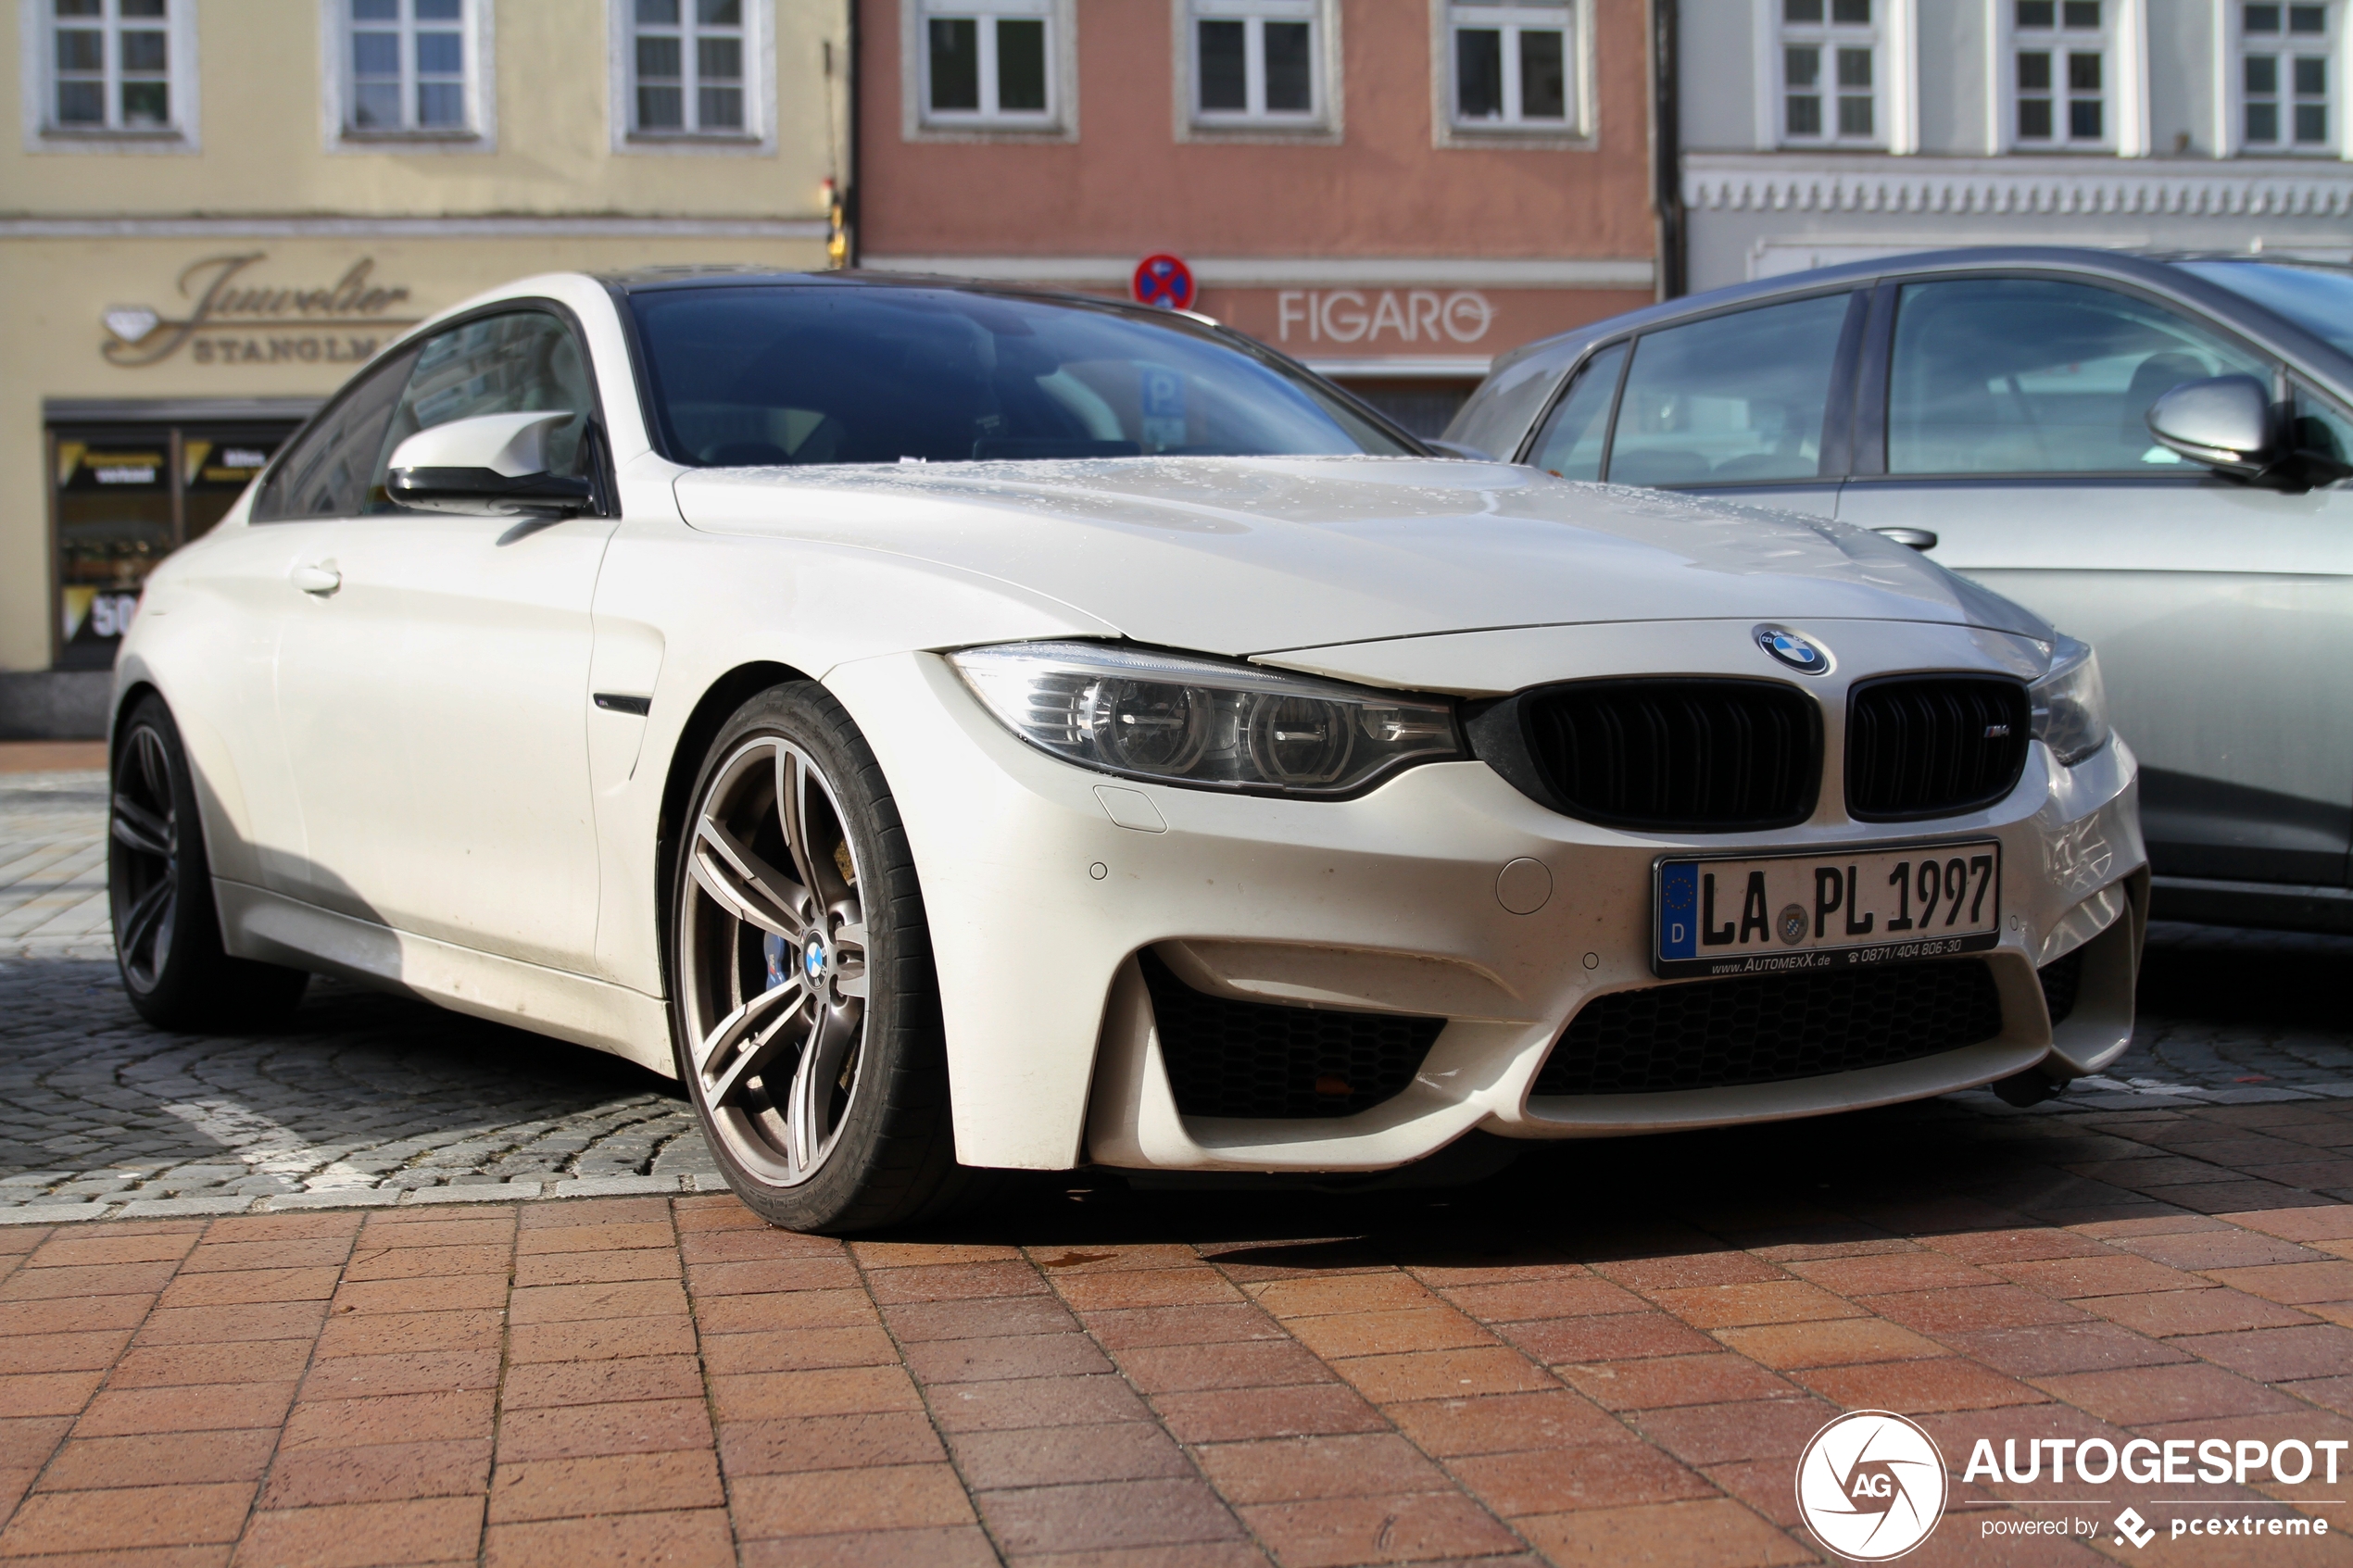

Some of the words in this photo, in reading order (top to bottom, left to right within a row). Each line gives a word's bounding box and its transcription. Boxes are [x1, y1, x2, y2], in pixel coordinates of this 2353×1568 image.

[139, 251, 409, 366] Juwelier
[1278, 290, 1495, 343] FIGARO
[193, 337, 389, 363] STANGLM
[1151, 377, 1176, 413] P
[1703, 871, 1769, 946] LA
[1815, 866, 1873, 938] PL
[1888, 854, 1994, 932] 1997
[1671, 922, 1684, 944] D
[1861, 945, 1919, 963] 0871/404
[1921, 939, 1962, 956] 806-30
